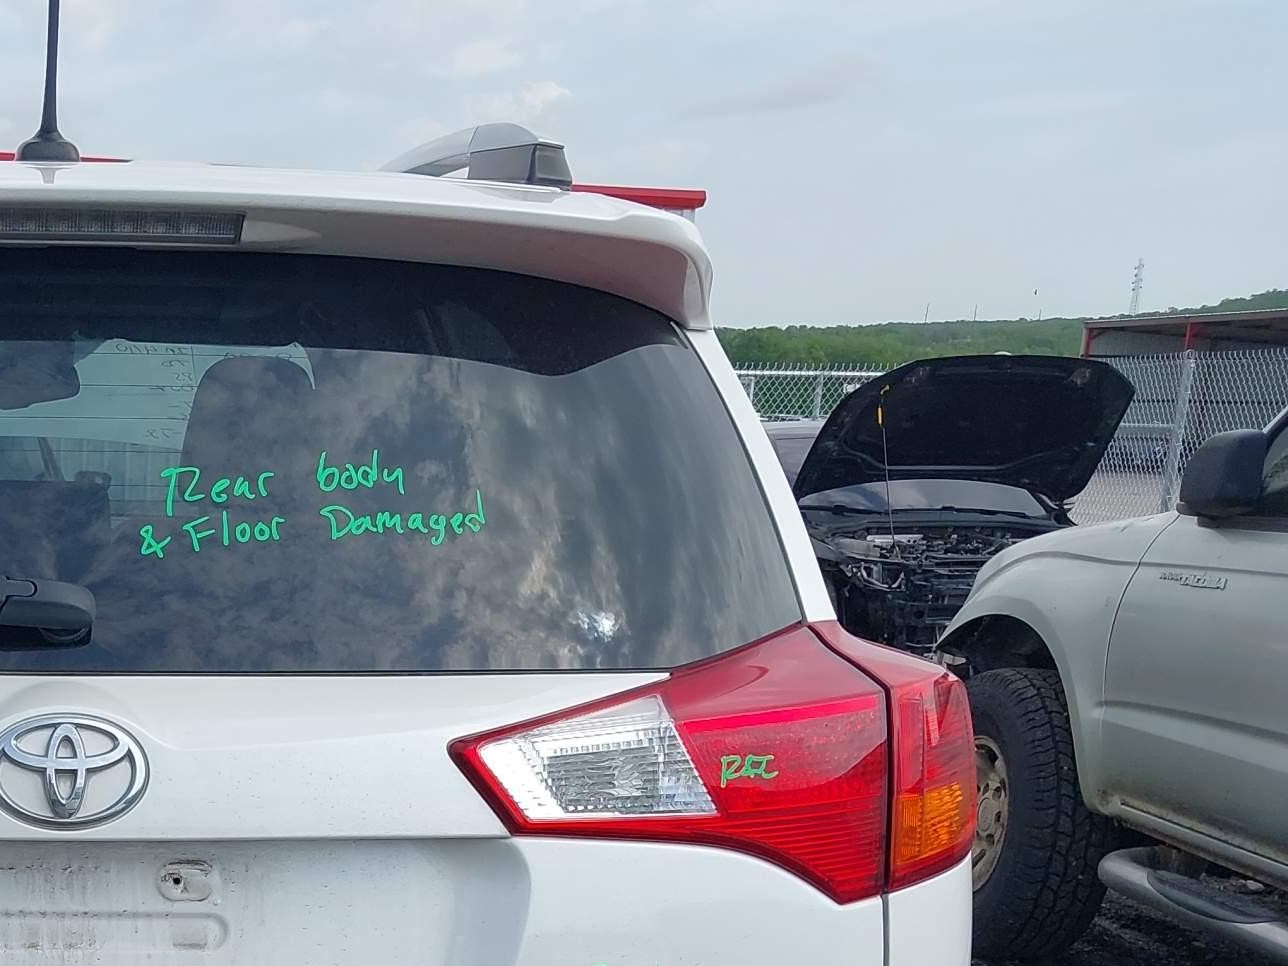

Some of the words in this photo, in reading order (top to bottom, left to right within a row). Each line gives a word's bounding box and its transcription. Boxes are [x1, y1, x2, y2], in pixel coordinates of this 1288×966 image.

[161, 466, 274, 516] Rear
[316, 449, 405, 495] body
[140, 524, 171, 558] &
[182, 510, 286, 551] Floor
[319, 489, 486, 546] Damaged
